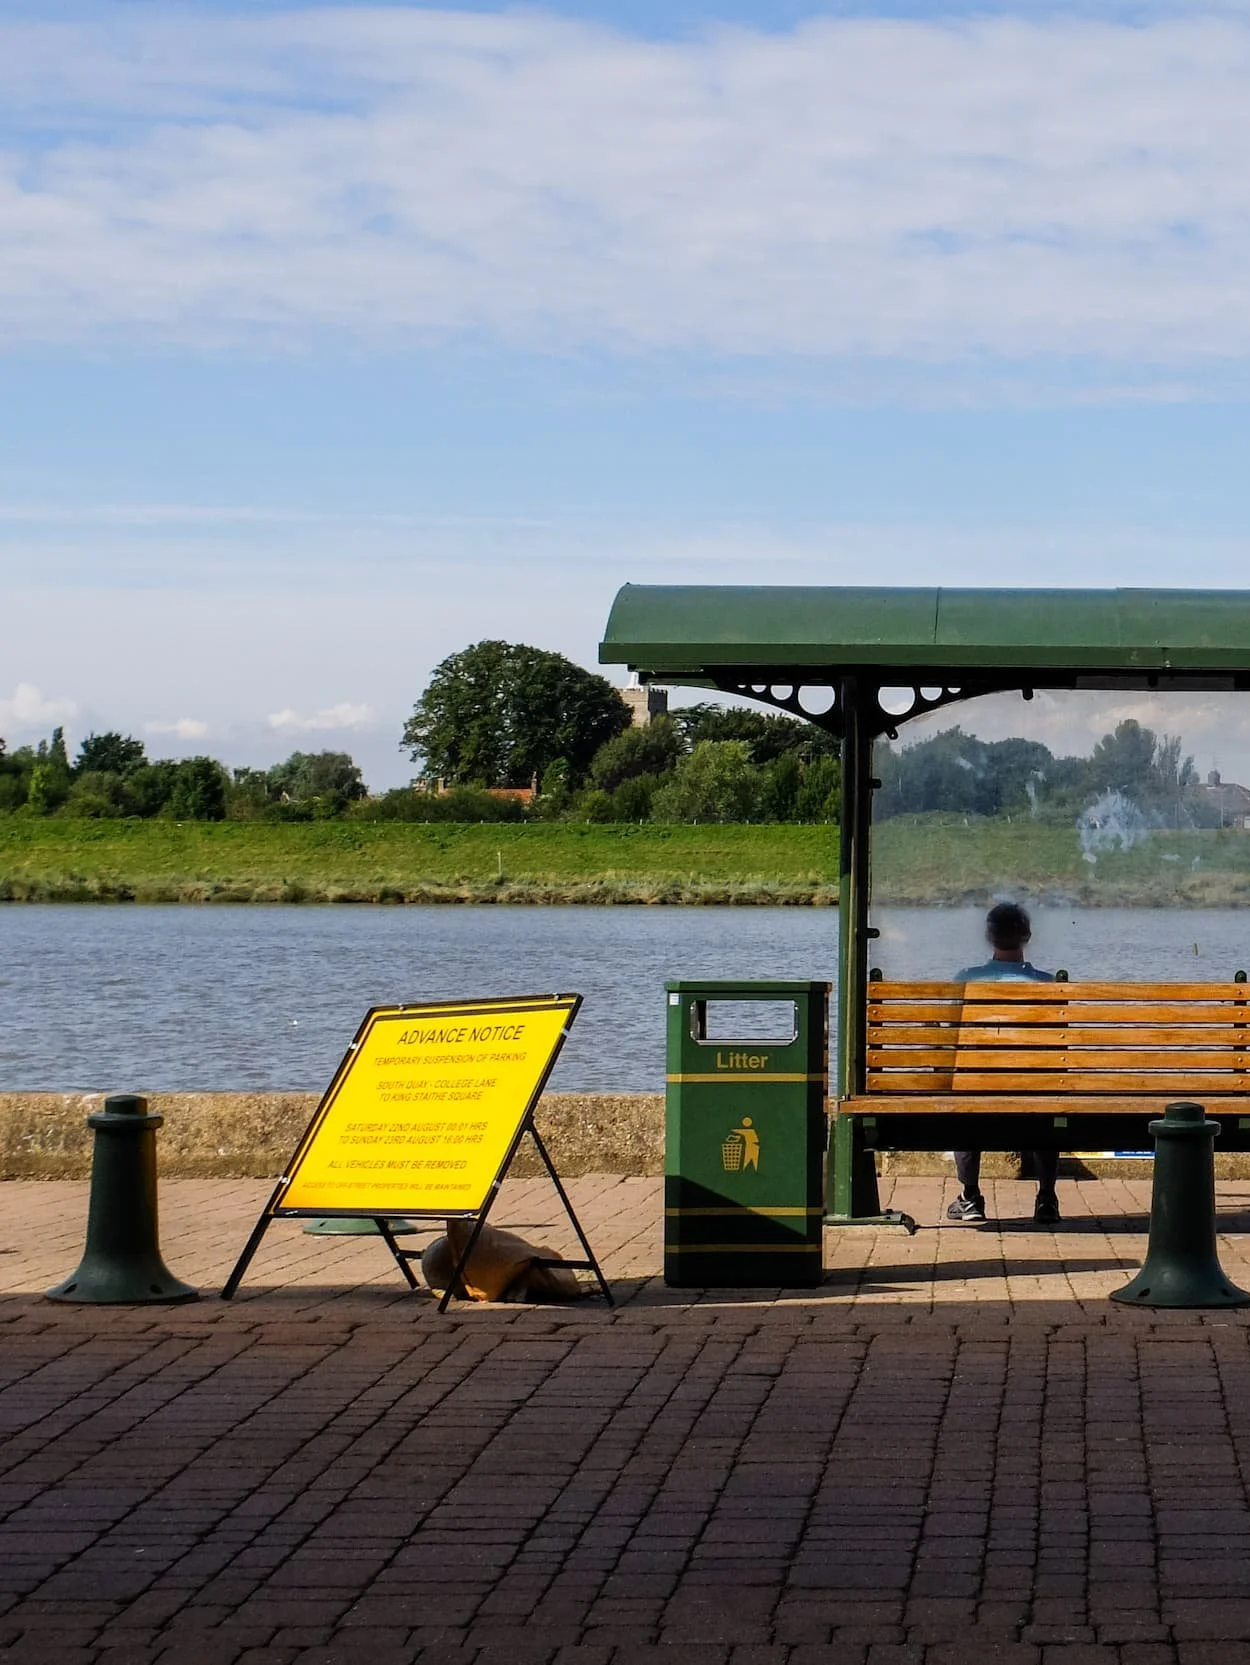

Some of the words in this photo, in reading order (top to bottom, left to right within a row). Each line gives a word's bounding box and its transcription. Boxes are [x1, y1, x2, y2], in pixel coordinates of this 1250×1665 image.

[398, 1027, 467, 1045] ADVANCE
[468, 1025, 525, 1042] NOTICE
[375, 1057, 422, 1067] TEMPORARY
[423, 1054, 475, 1065] SUSPENSION
[476, 1053, 488, 1063] OF
[489, 1052, 527, 1062] PARKING
[717, 1052, 768, 1068] Litter
[376, 1080, 404, 1090] SOUTH
[405, 1079, 430, 1089] QUAY
[434, 1079, 475, 1089] COLLEGE
[475, 1078, 497, 1088] LANE
[379, 1092, 391, 1102] TO
[391, 1092, 412, 1102] KING
[412, 1091, 447, 1101] STAITHE
[448, 1091, 484, 1101] SQUARE
[345, 1122, 388, 1132] SATURDAY
[388, 1122, 411, 1132] 22ND
[410, 1122, 446, 1132] AUGUST
[468, 1121, 488, 1131] HRS
[338, 1135, 351, 1144] TO
[350, 1135, 383, 1144] SUNDAY
[384, 1135, 406, 1144] 23RD
[406, 1135, 442, 1144] AUGUST
[464, 1134, 485, 1144] HRS
[327, 1160, 343, 1169] ALL
[345, 1160, 386, 1169] VEHICLES
[386, 1160, 410, 1169] MUST
[410, 1160, 424, 1170] BE
[424, 1160, 468, 1170] REMOVED
